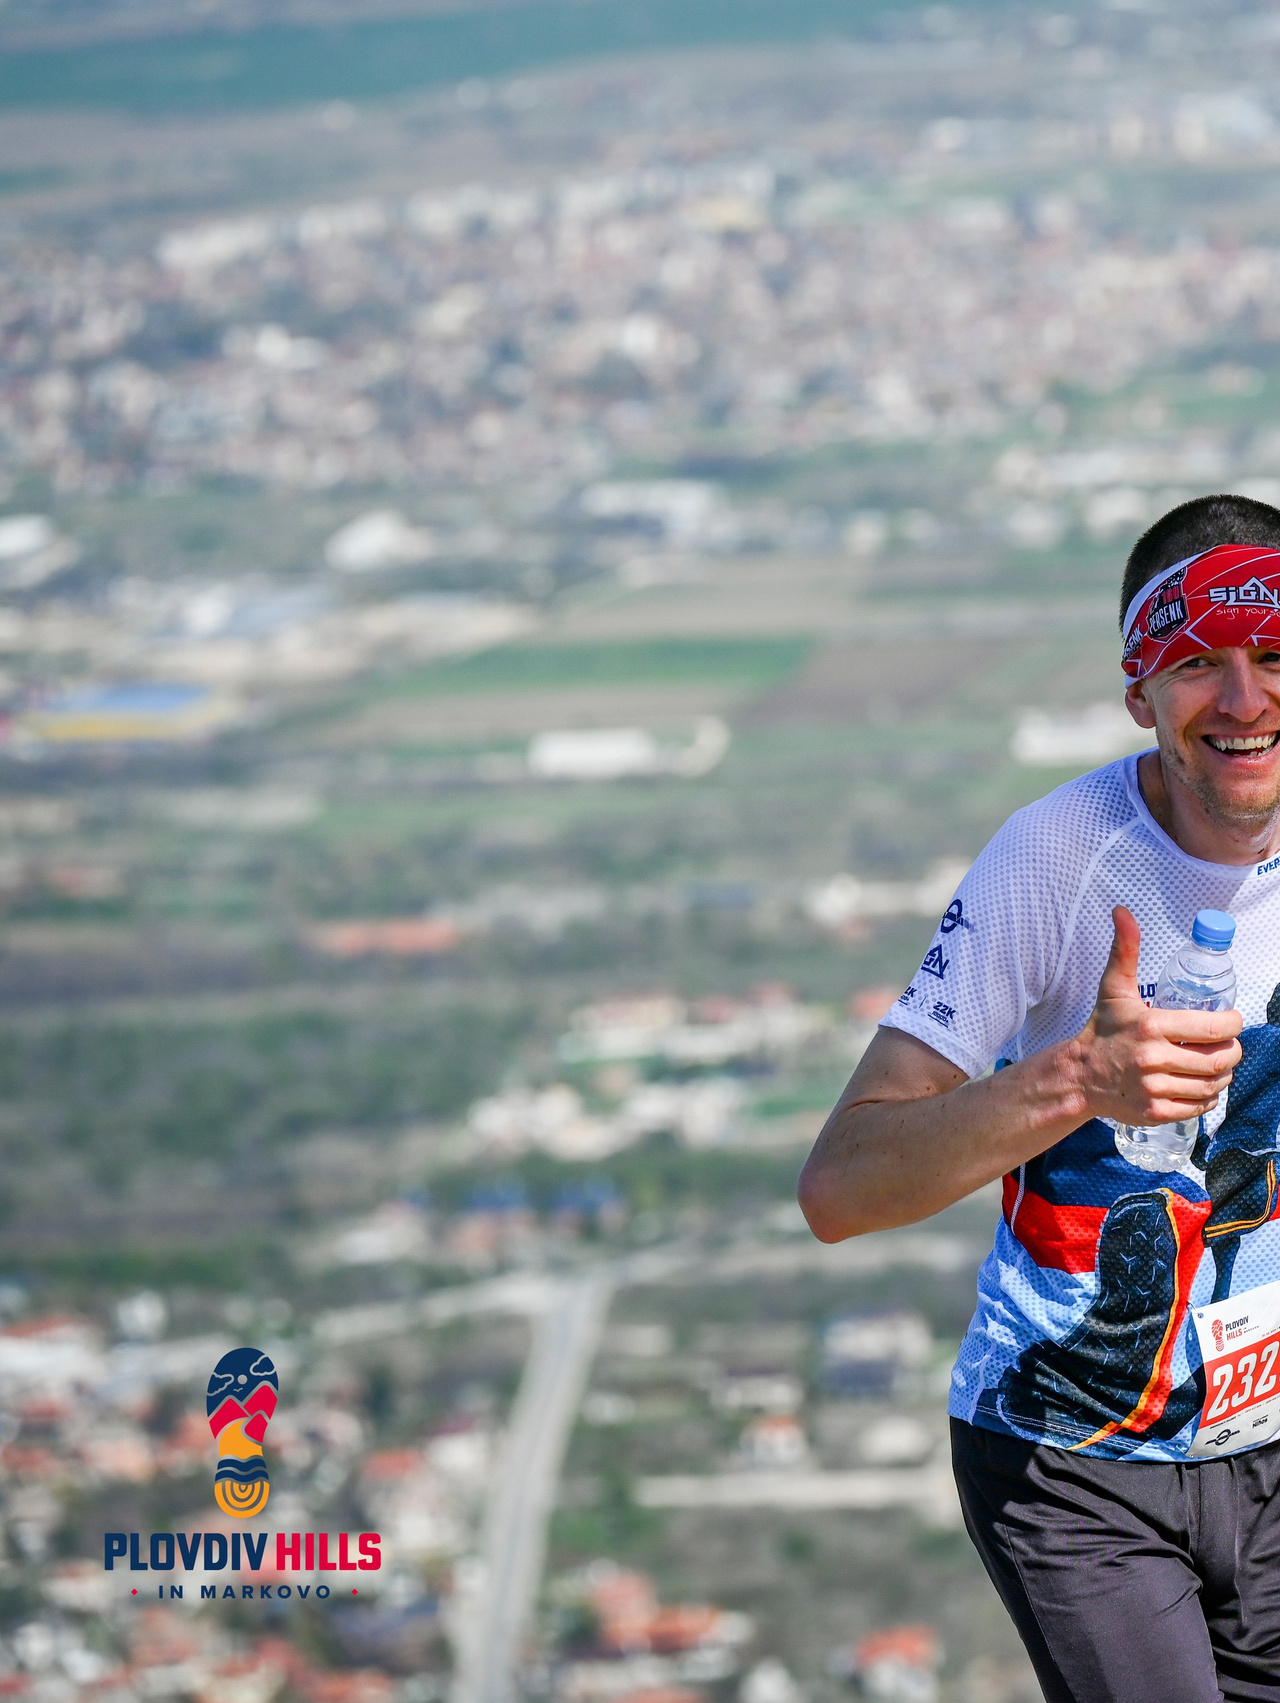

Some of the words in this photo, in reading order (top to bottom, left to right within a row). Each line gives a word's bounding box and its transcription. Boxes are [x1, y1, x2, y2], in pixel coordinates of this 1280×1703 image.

[1149, 600, 1184, 635] PERSENK
[1216, 607, 1240, 620] sign
[933, 1001, 956, 1020] 22K
[1225, 1316, 1249, 1331] PLOVDIV
[1226, 1328, 1243, 1341] HILLS
